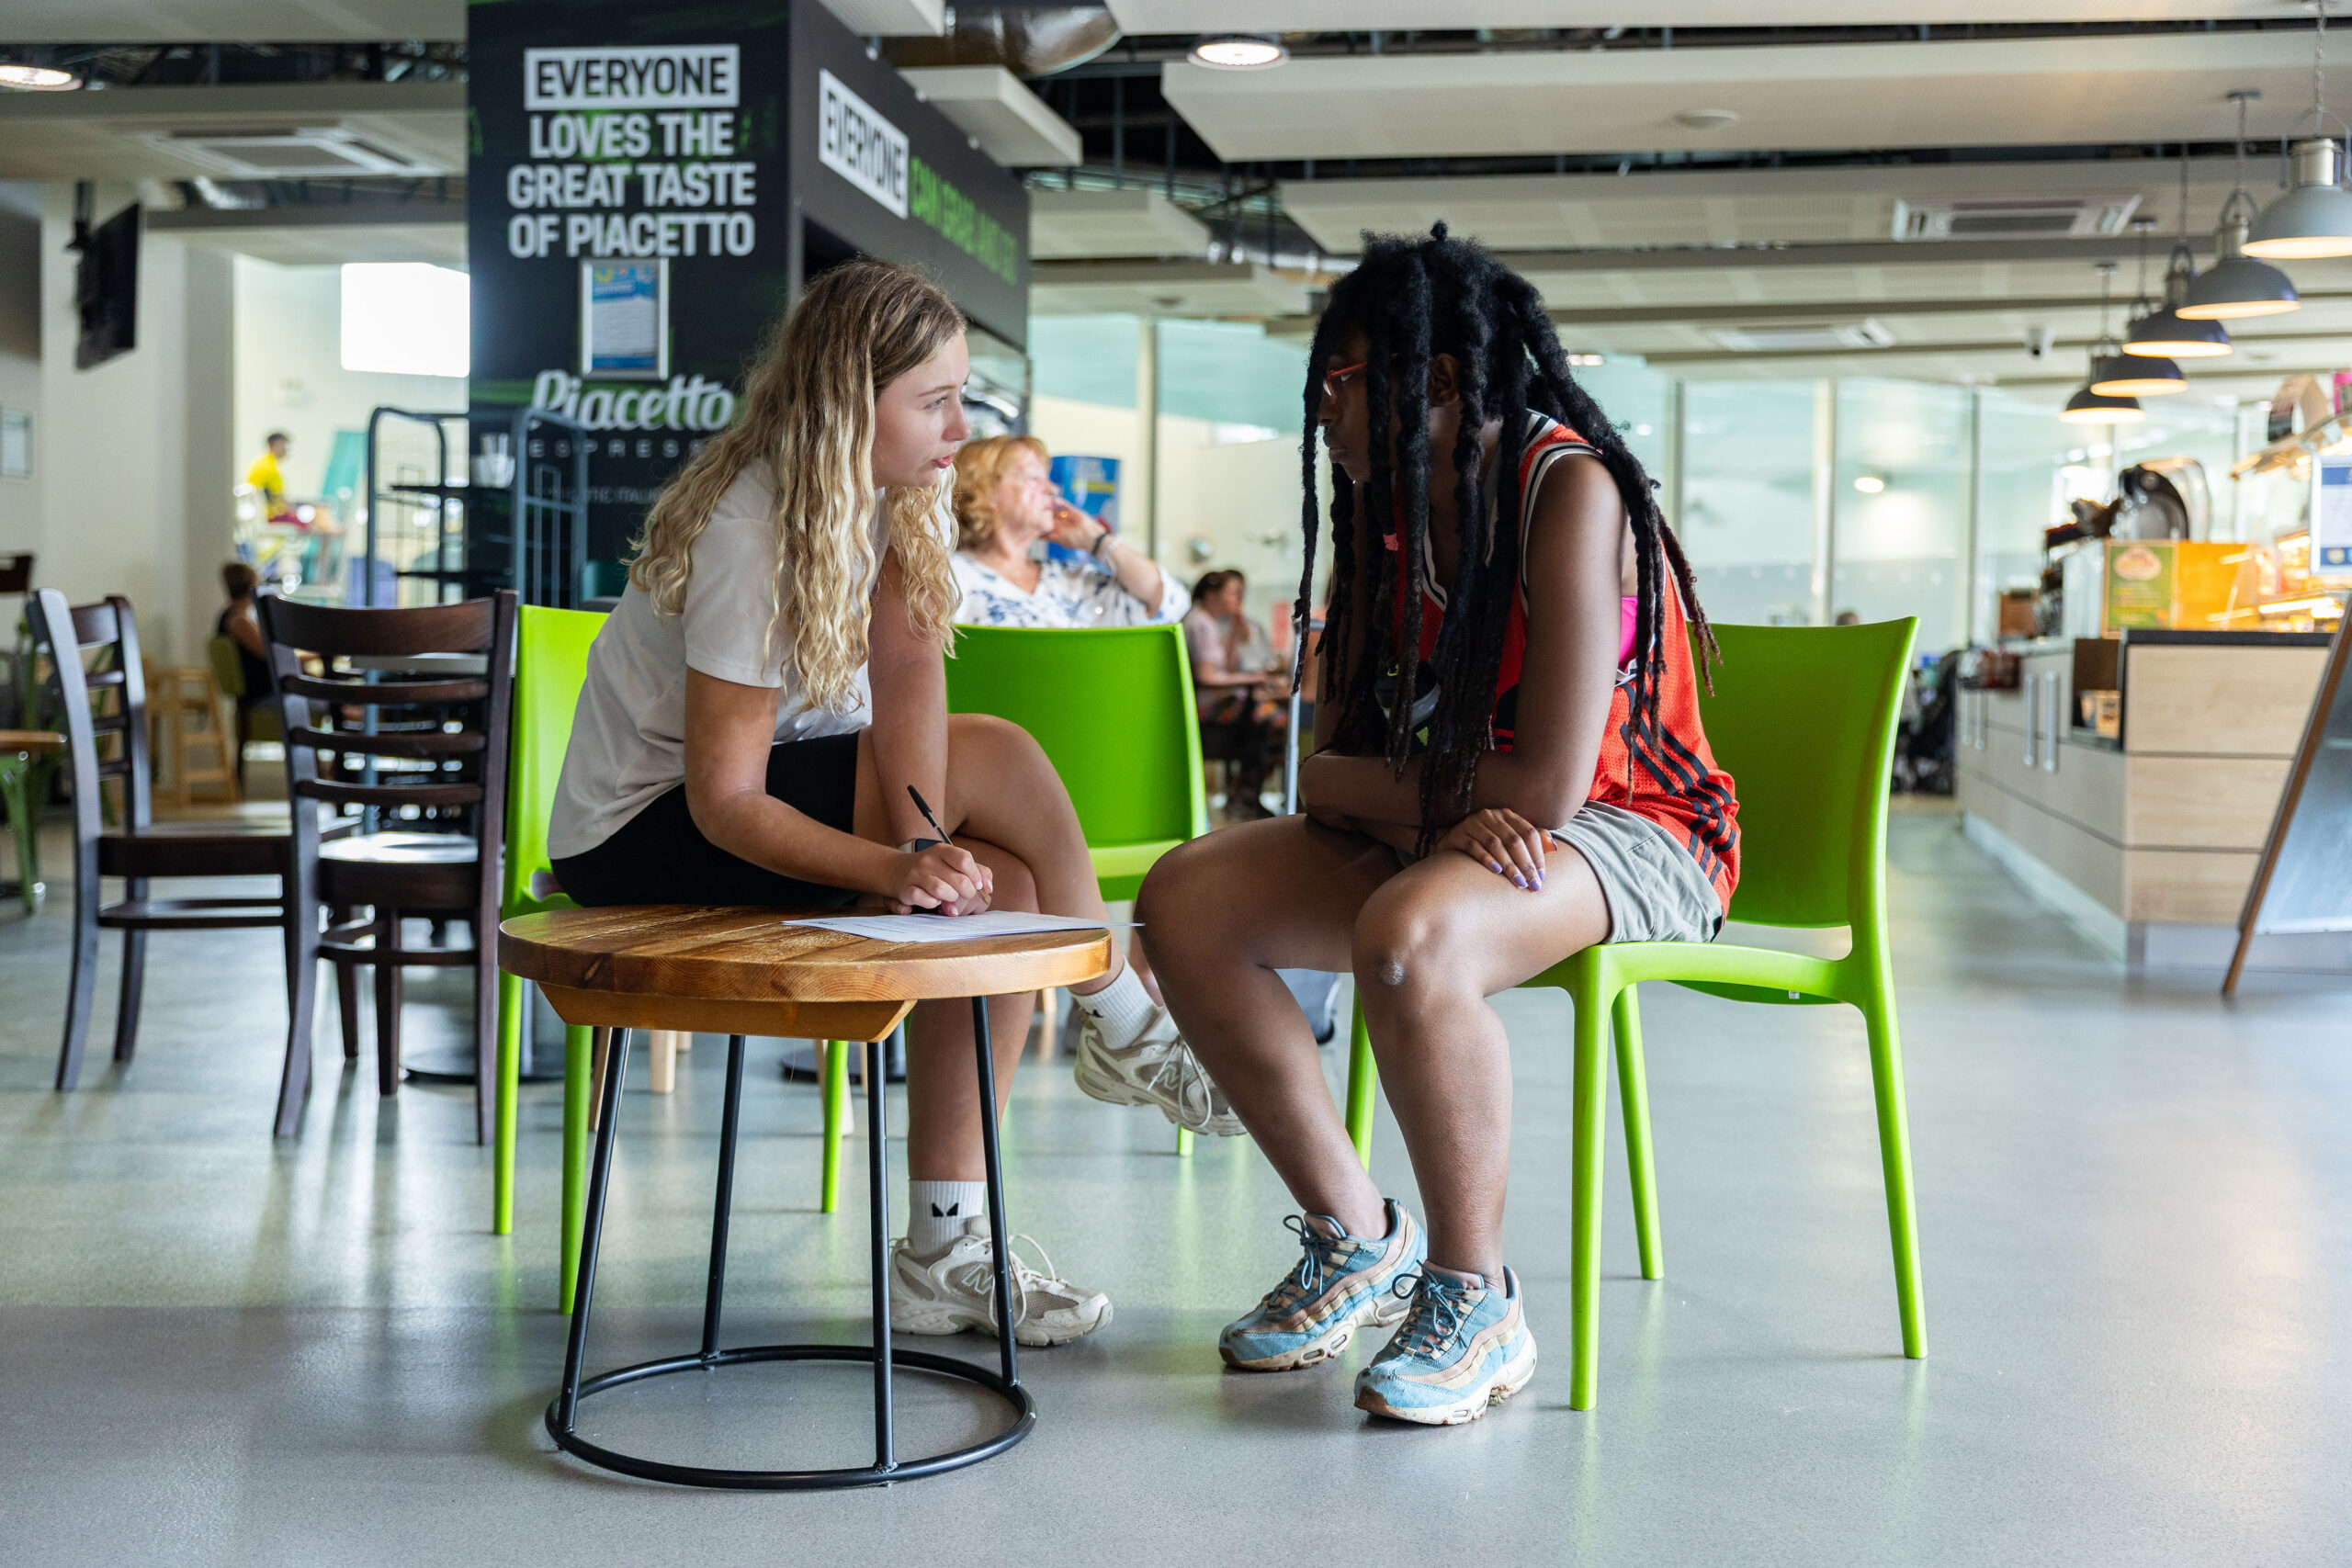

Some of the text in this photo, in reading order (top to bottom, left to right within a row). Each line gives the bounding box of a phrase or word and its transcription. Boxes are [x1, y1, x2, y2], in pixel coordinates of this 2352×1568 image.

[537, 57, 728, 96] EVERYONE
[529, 111, 735, 159] LOVES THE
[828, 90, 903, 200] EVERYONE
[507, 161, 756, 209] GREAT TASTE
[508, 211, 755, 258] OF PIACETTO
[528, 368, 735, 432] Piacetto
